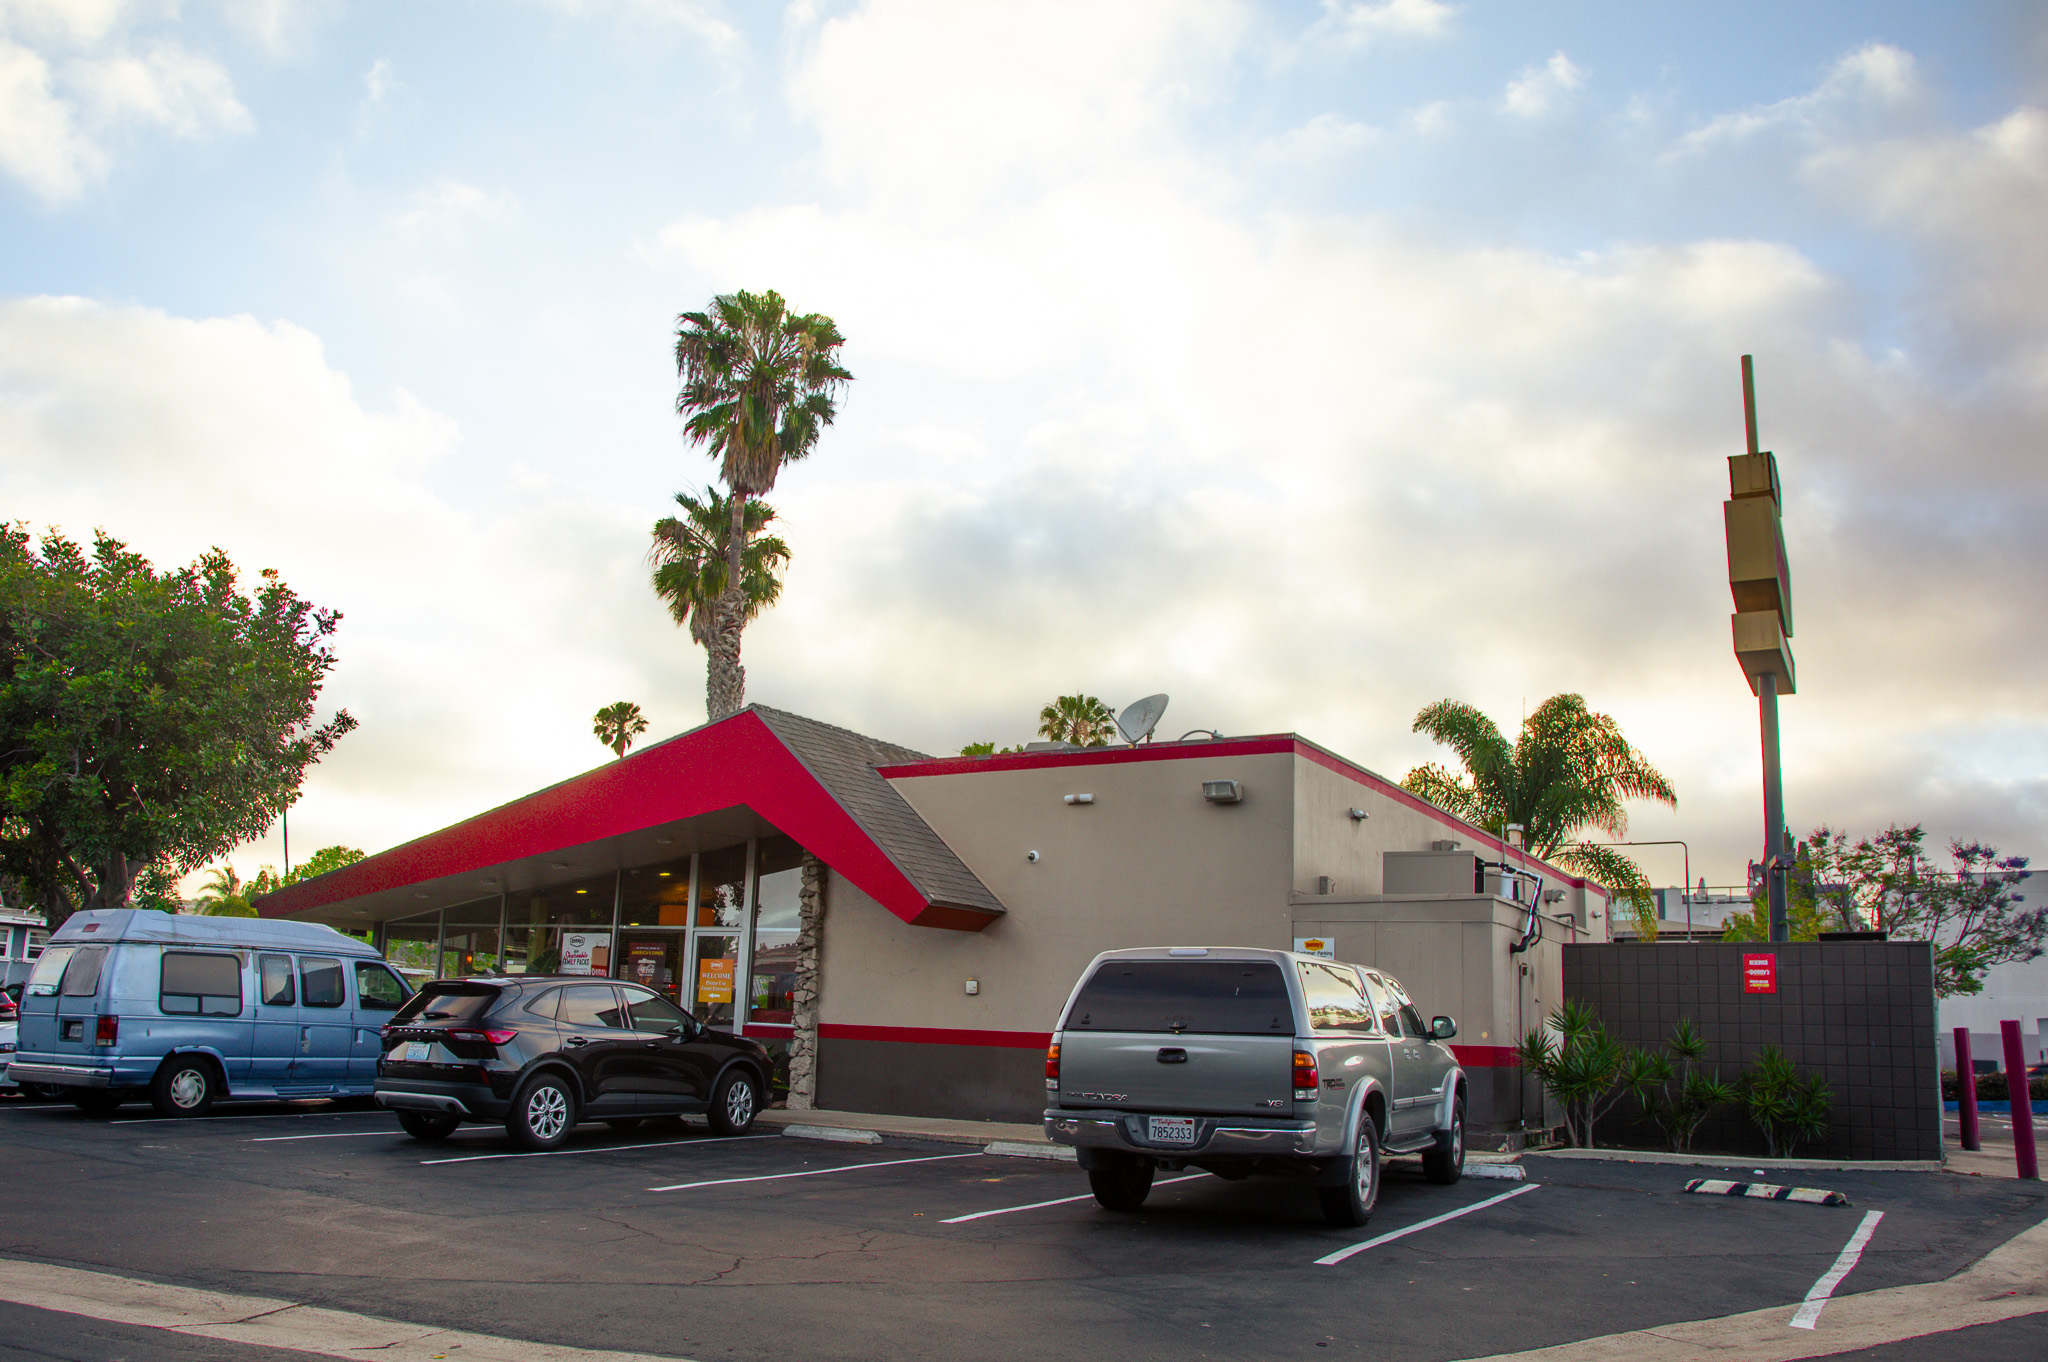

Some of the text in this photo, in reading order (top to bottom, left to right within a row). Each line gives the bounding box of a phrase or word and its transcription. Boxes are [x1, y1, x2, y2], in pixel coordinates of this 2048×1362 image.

[564, 951, 588, 961] Shareable
[1322, 1078, 1336, 1090] TRD
[1082, 1092, 1128, 1101] TUNDRA
[1158, 1118, 1184, 1126] California
[1152, 1126, 1192, 1139] 78523S3
